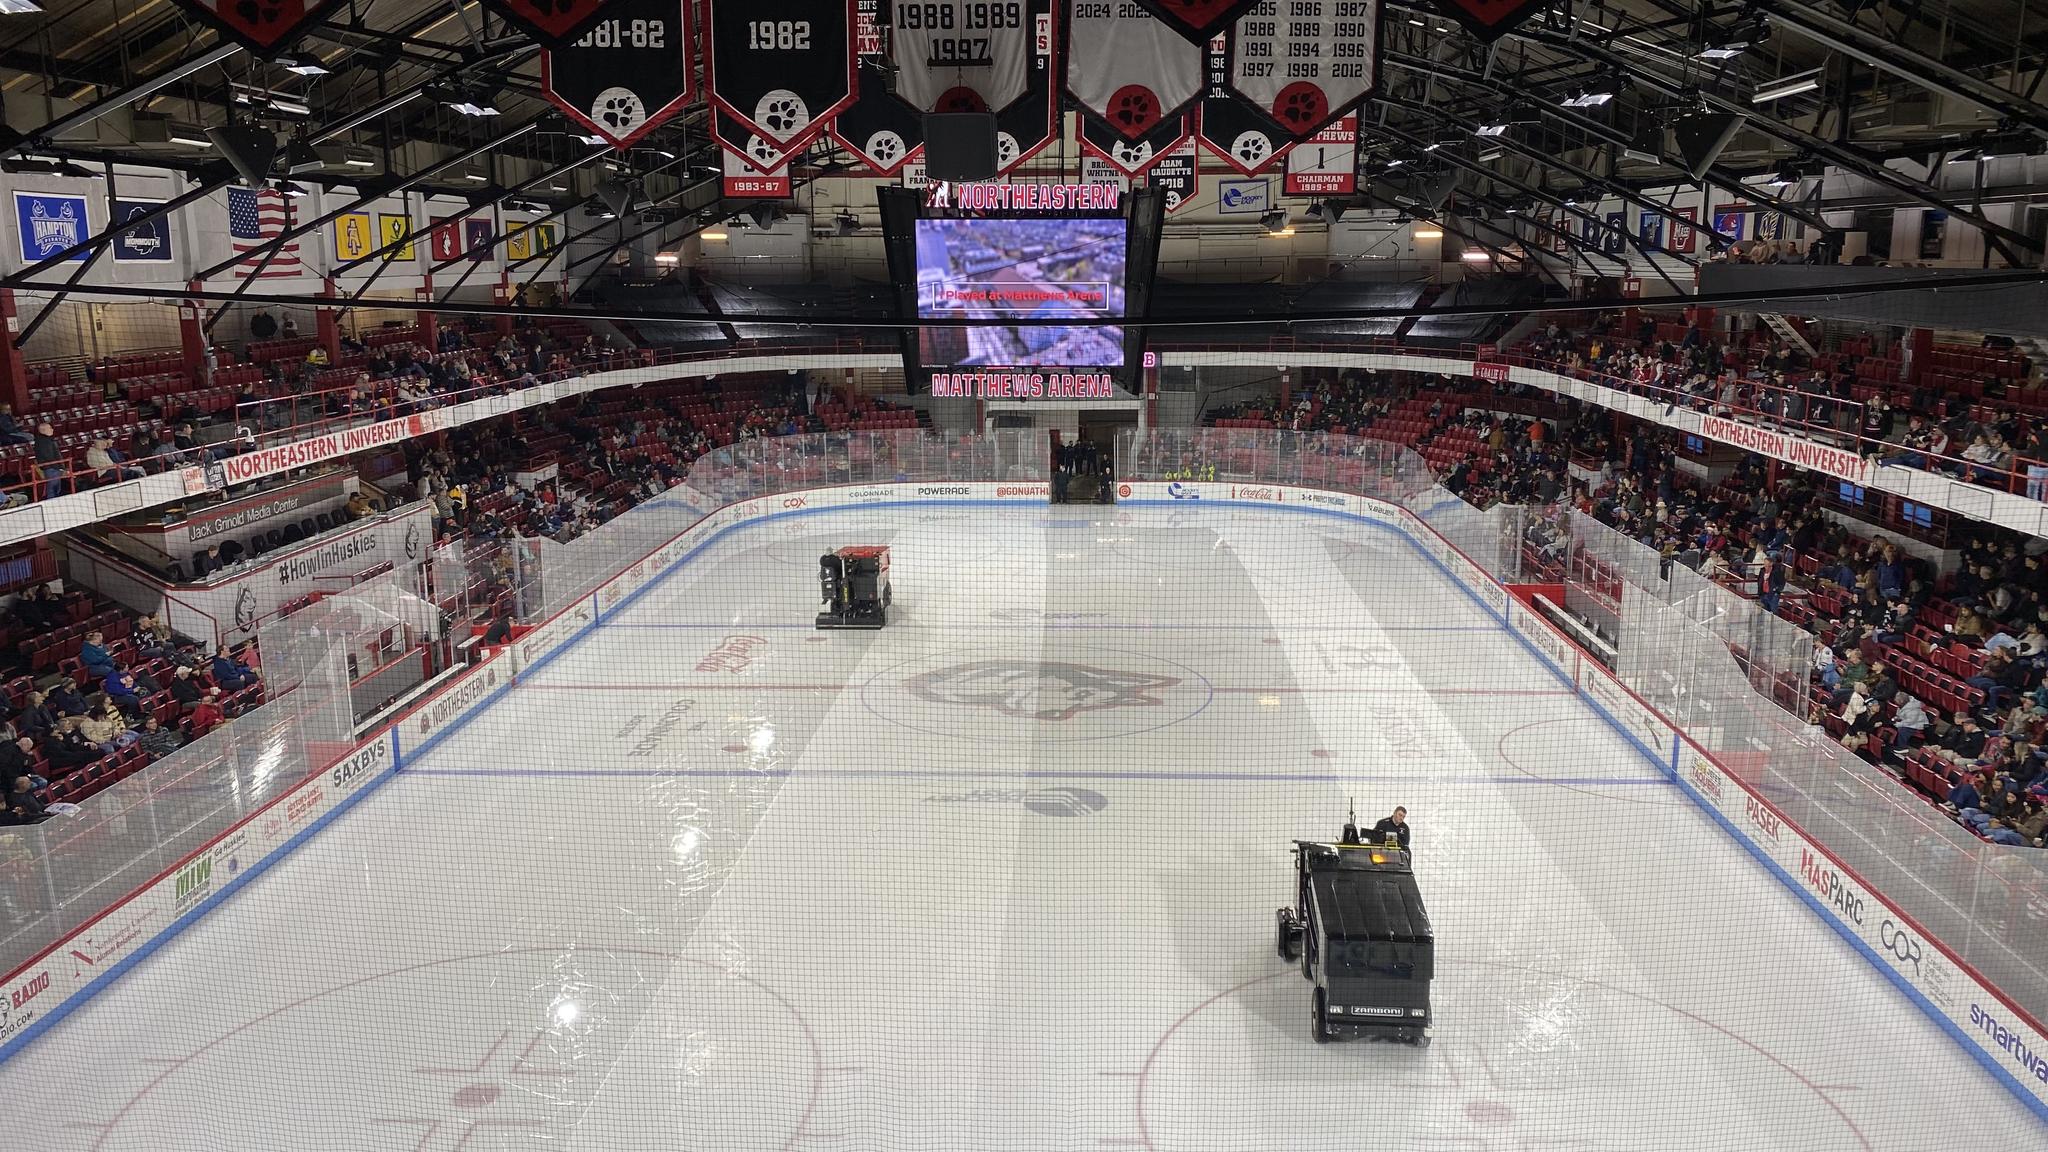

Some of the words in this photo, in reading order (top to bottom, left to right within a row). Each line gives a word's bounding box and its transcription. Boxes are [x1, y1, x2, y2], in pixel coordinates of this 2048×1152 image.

[898, 4, 954, 29] 1988
[965, 3, 1020, 29] 1989
[1076, 4, 1111, 18] 2024
[1290, 2, 1322, 16] 1986
[1335, 2, 1367, 16] 1987
[748, 21, 810, 50] 1982
[1244, 22, 1275, 36] 1988
[1288, 22, 1320, 37] 1989
[1333, 23, 1365, 37] 1990
[931, 38, 988, 60] 1997
[1245, 42, 1273, 57] 1991
[1288, 42, 1319, 57] 1994
[1333, 43, 1364, 57] 1996
[1243, 62, 1274, 77] 1997
[1287, 62, 1318, 77] 1998
[1332, 63, 1363, 78] 2012
[1160, 160, 1183, 168] ADAM
[1316, 146, 1325, 170] 1
[1152, 168, 1192, 177] GAUDETTE
[1297, 175, 1344, 183] CHAIRMAN
[957, 183, 1118, 210] NORTHEASTERN
[36, 220, 75, 241] HAMPTON
[989, 292, 1000, 302] at
[1003, 290, 1064, 302] Matthews
[1067, 290, 1102, 302] Arena
[1144, 352, 1156, 368] B
[932, 373, 1041, 399] MATTHEWS
[1046, 373, 1112, 398] ARENA
[227, 441, 338, 481] NORTHEASTERN
[341, 419, 407, 453] UNIVERSITY
[1703, 415, 1785, 458] NORTHEASTERN
[1789, 440, 1869, 481] UNIVERSITY
[783, 495, 807, 509] COX
[849, 489, 894, 498] COLONNADE
[917, 487, 970, 497] POWERADE
[996, 486, 1050, 497] @GONUATHL
[189, 522, 212, 541] Jack
[214, 508, 245, 533] Grinold
[246, 501, 272, 522] Media
[273, 497, 300, 515] Center
[279, 533, 377, 585] #HowlinHuskies
[432, 674, 486, 726] NORTHEASTERN
[333, 739, 385, 789] SAXBYS
[1746, 796, 1781, 843] PASEK
[1801, 847, 1865, 926] MASPARC
[12, 970, 50, 1010] RADIO
[1353, 1006, 1402, 1015] ZAMBONI
[0, 1010, 34, 1041] DIO.COM
[1969, 1002, 2048, 1085] smartwa
